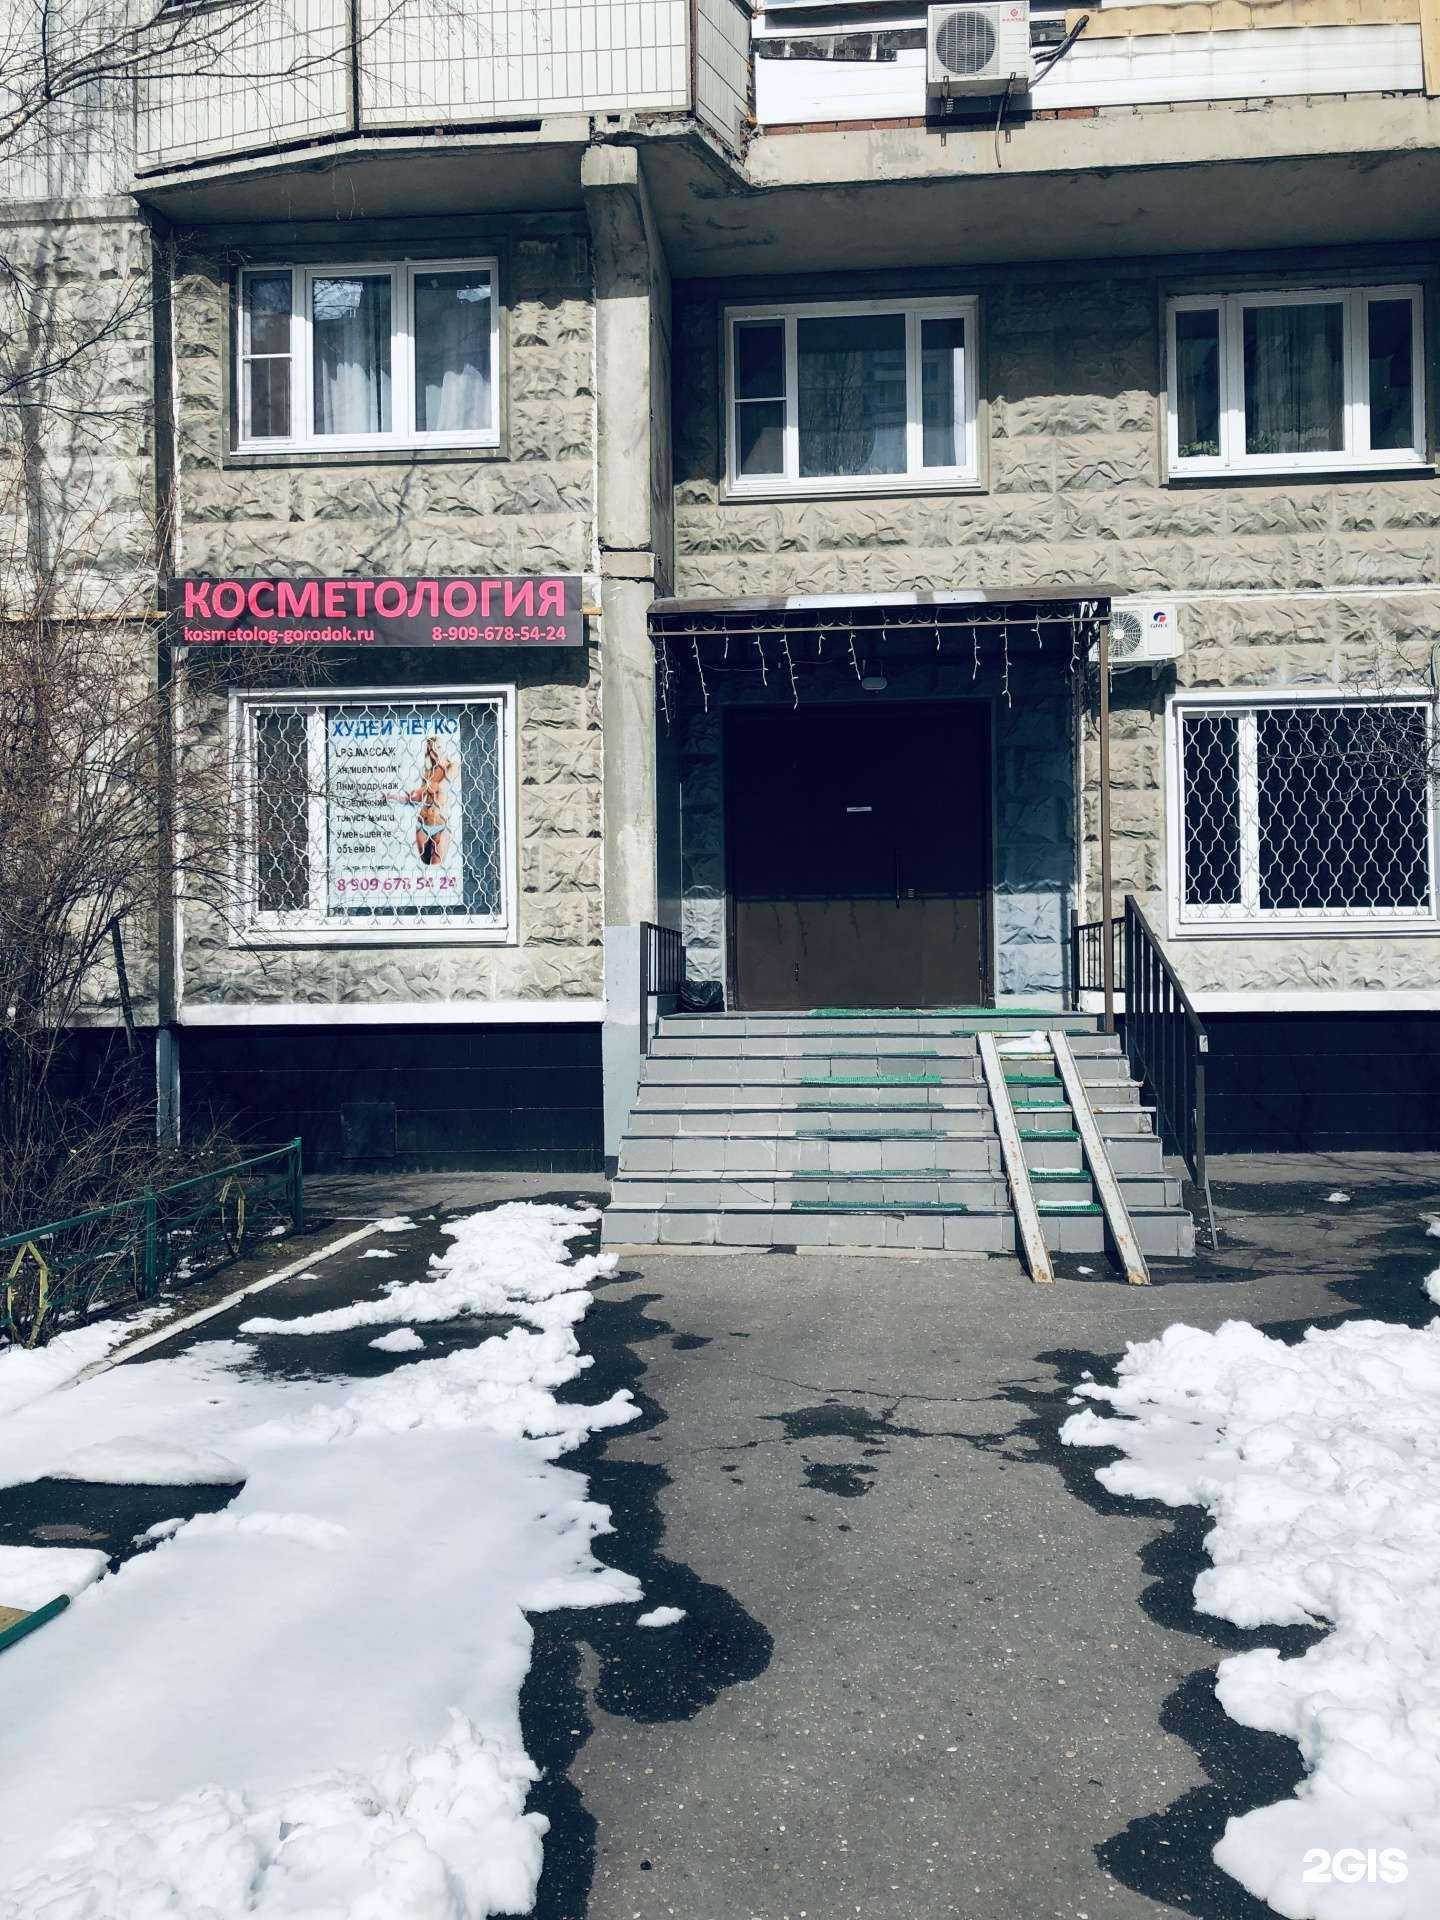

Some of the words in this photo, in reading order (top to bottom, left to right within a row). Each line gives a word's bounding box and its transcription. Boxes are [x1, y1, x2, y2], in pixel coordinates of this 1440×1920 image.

[184, 580, 565, 618] КОСМЕТОЛОГИЯ
[184, 626, 375, 643] kosmetolog-gorodok.ru
[432, 626, 567, 642] 8-909-678-54-24
[398, 718, 458, 735] ЛЕГКО
[337, 879, 346, 892] 8
[350, 877, 379, 891] 909
